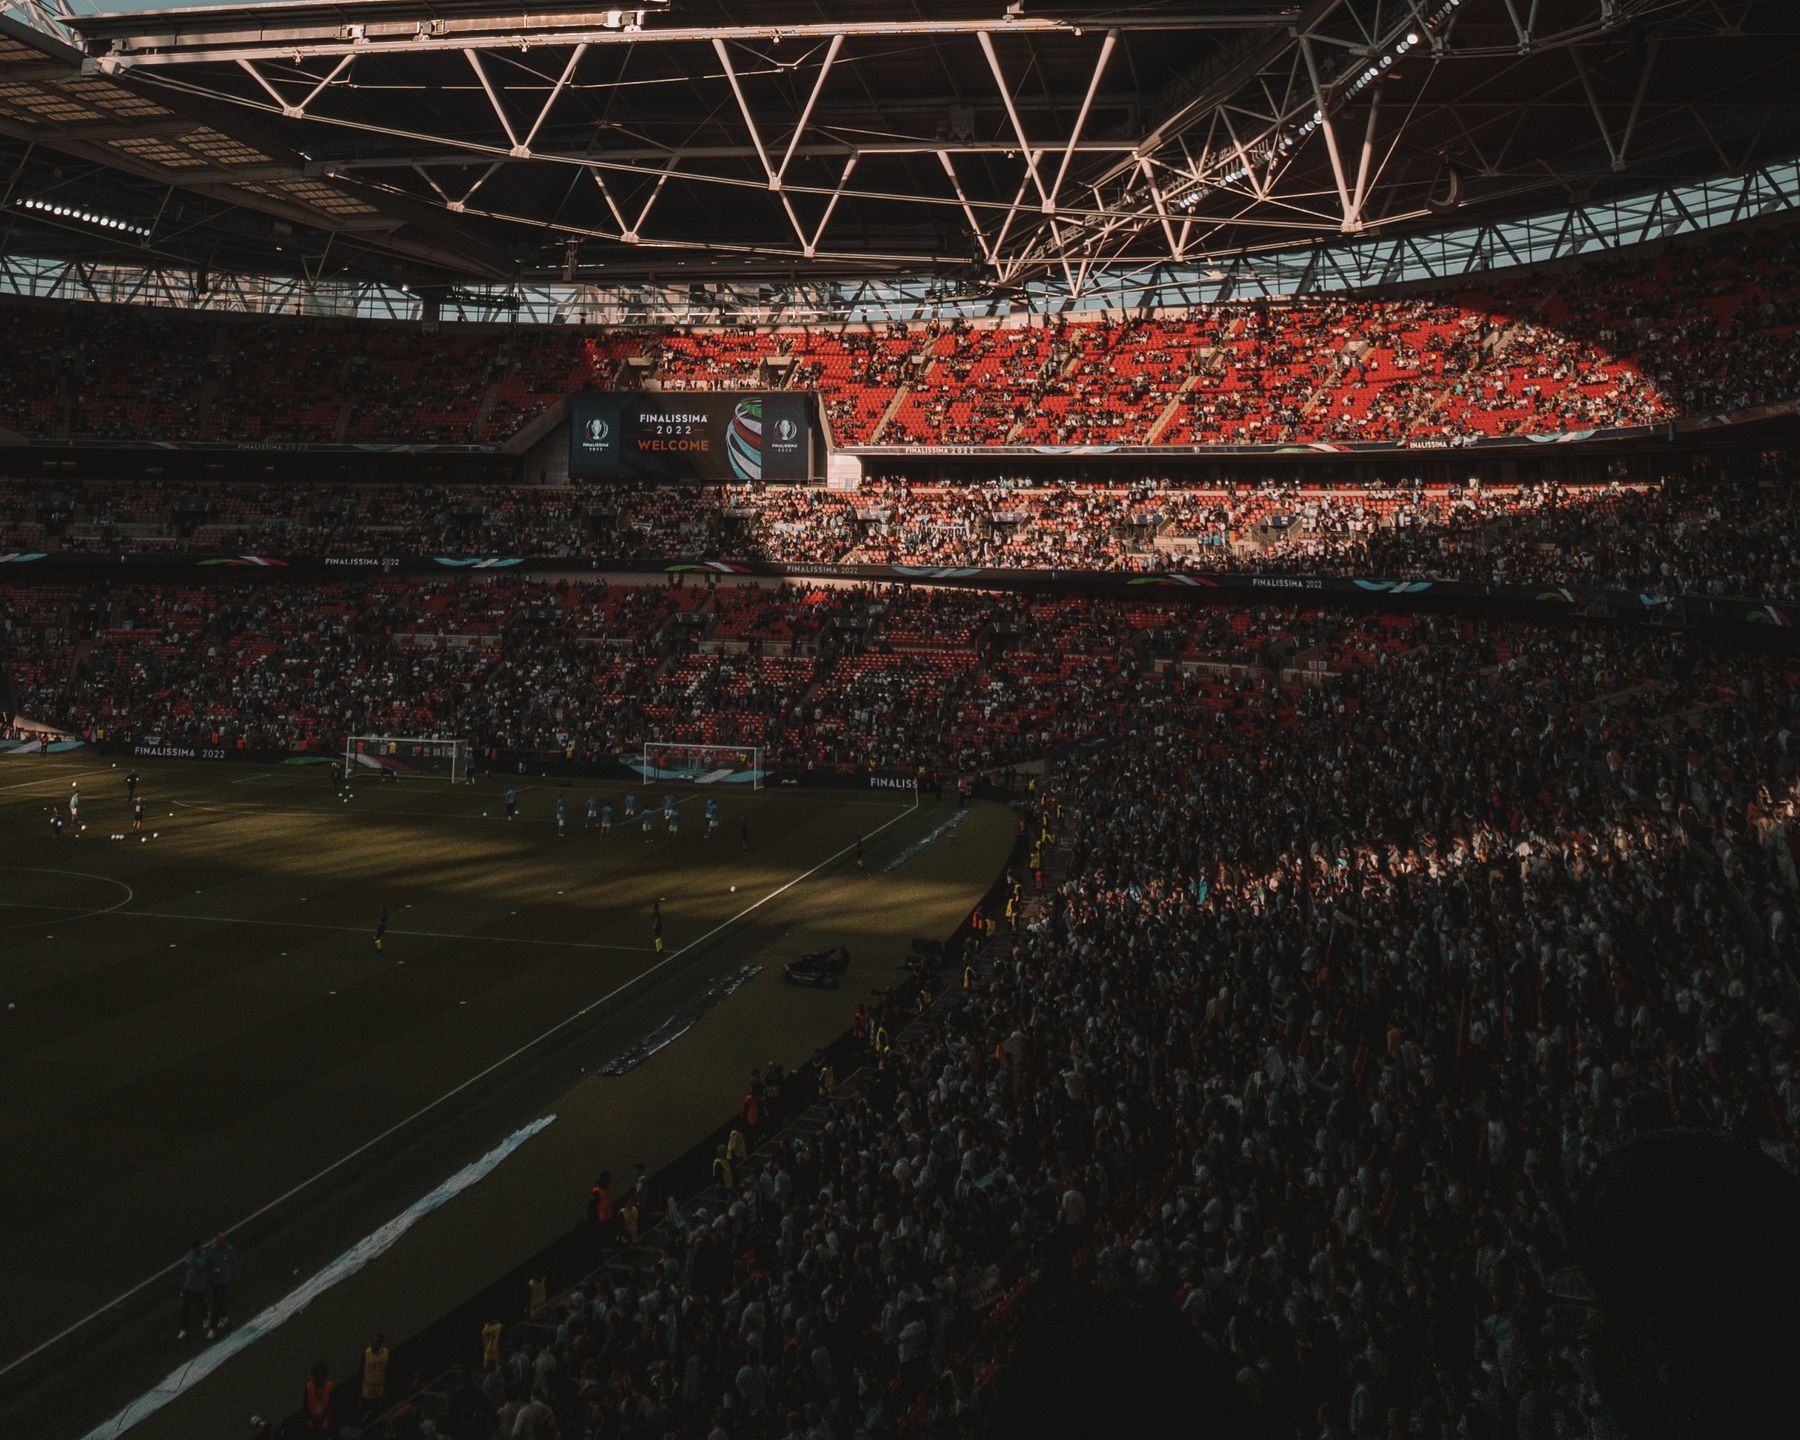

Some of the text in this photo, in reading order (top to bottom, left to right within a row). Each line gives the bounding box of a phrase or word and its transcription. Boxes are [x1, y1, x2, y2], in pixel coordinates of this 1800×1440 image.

[640, 414, 708, 423] FINALISSIMA
[656, 425, 692, 435] 2022
[638, 439, 710, 452] WELCOME
[1410, 441, 1448, 449] INALISSIMA
[325, 558, 400, 566] FINALISSIMA 222
[786, 565, 858, 574] FINALISSIMA 2022
[1252, 578, 1323, 589] FINALISSIMA 2022
[134, 746, 225, 759] FINALISSIMA 2022
[870, 777, 918, 789] FINALISS
